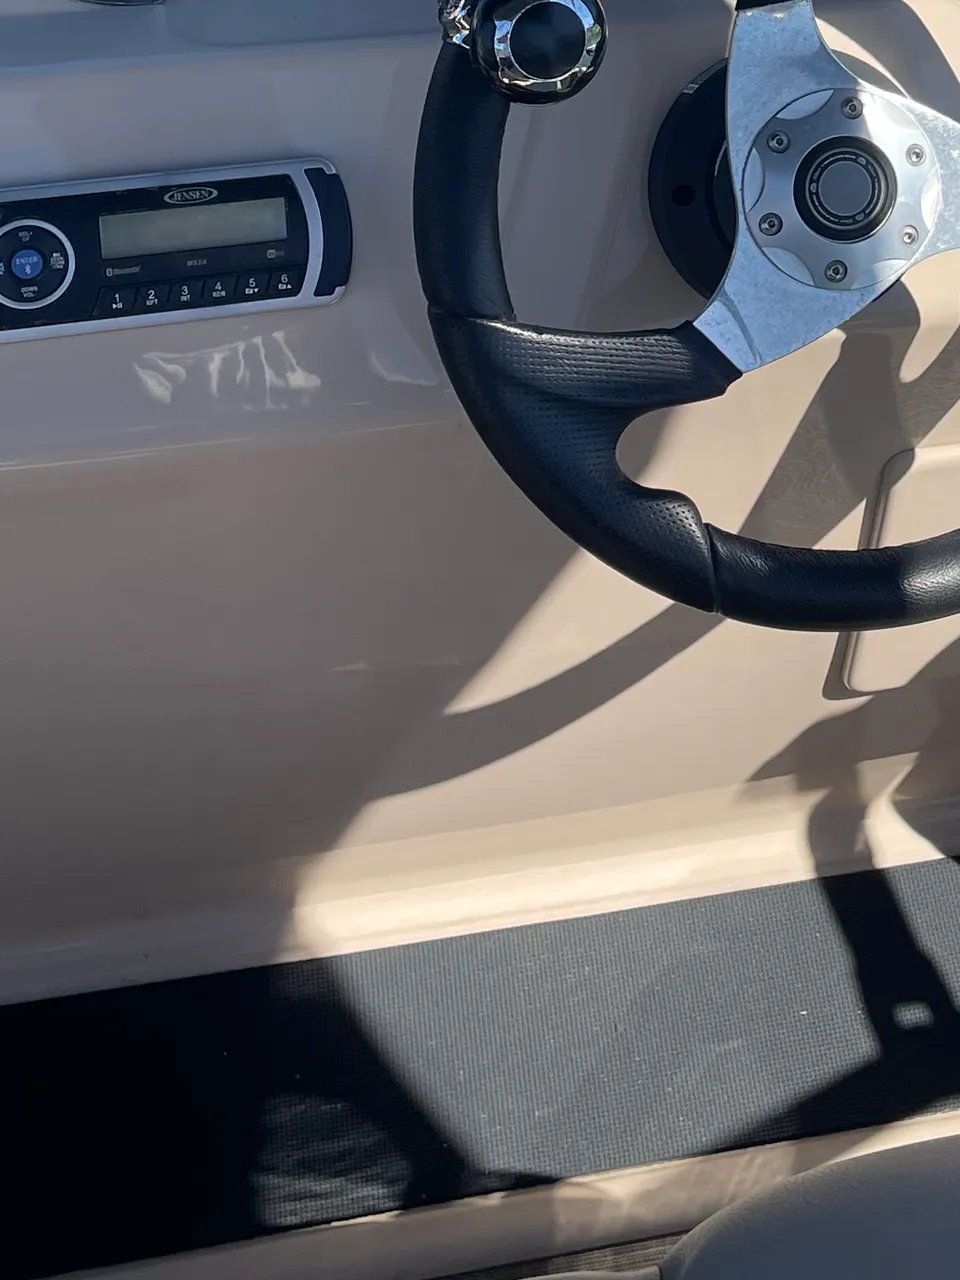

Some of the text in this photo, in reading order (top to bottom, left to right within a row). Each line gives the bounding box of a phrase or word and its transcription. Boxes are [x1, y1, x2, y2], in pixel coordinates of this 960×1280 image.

[170, 189, 210, 201] JENSEN
[16, 255, 38, 266] ENTER
[248, 277, 256, 288] 5
[280, 273, 288, 283] 6
[181, 285, 189, 296] 3
[214, 281, 222, 291] 4
[114, 293, 120, 303] 1
[147, 289, 156, 300] 2
